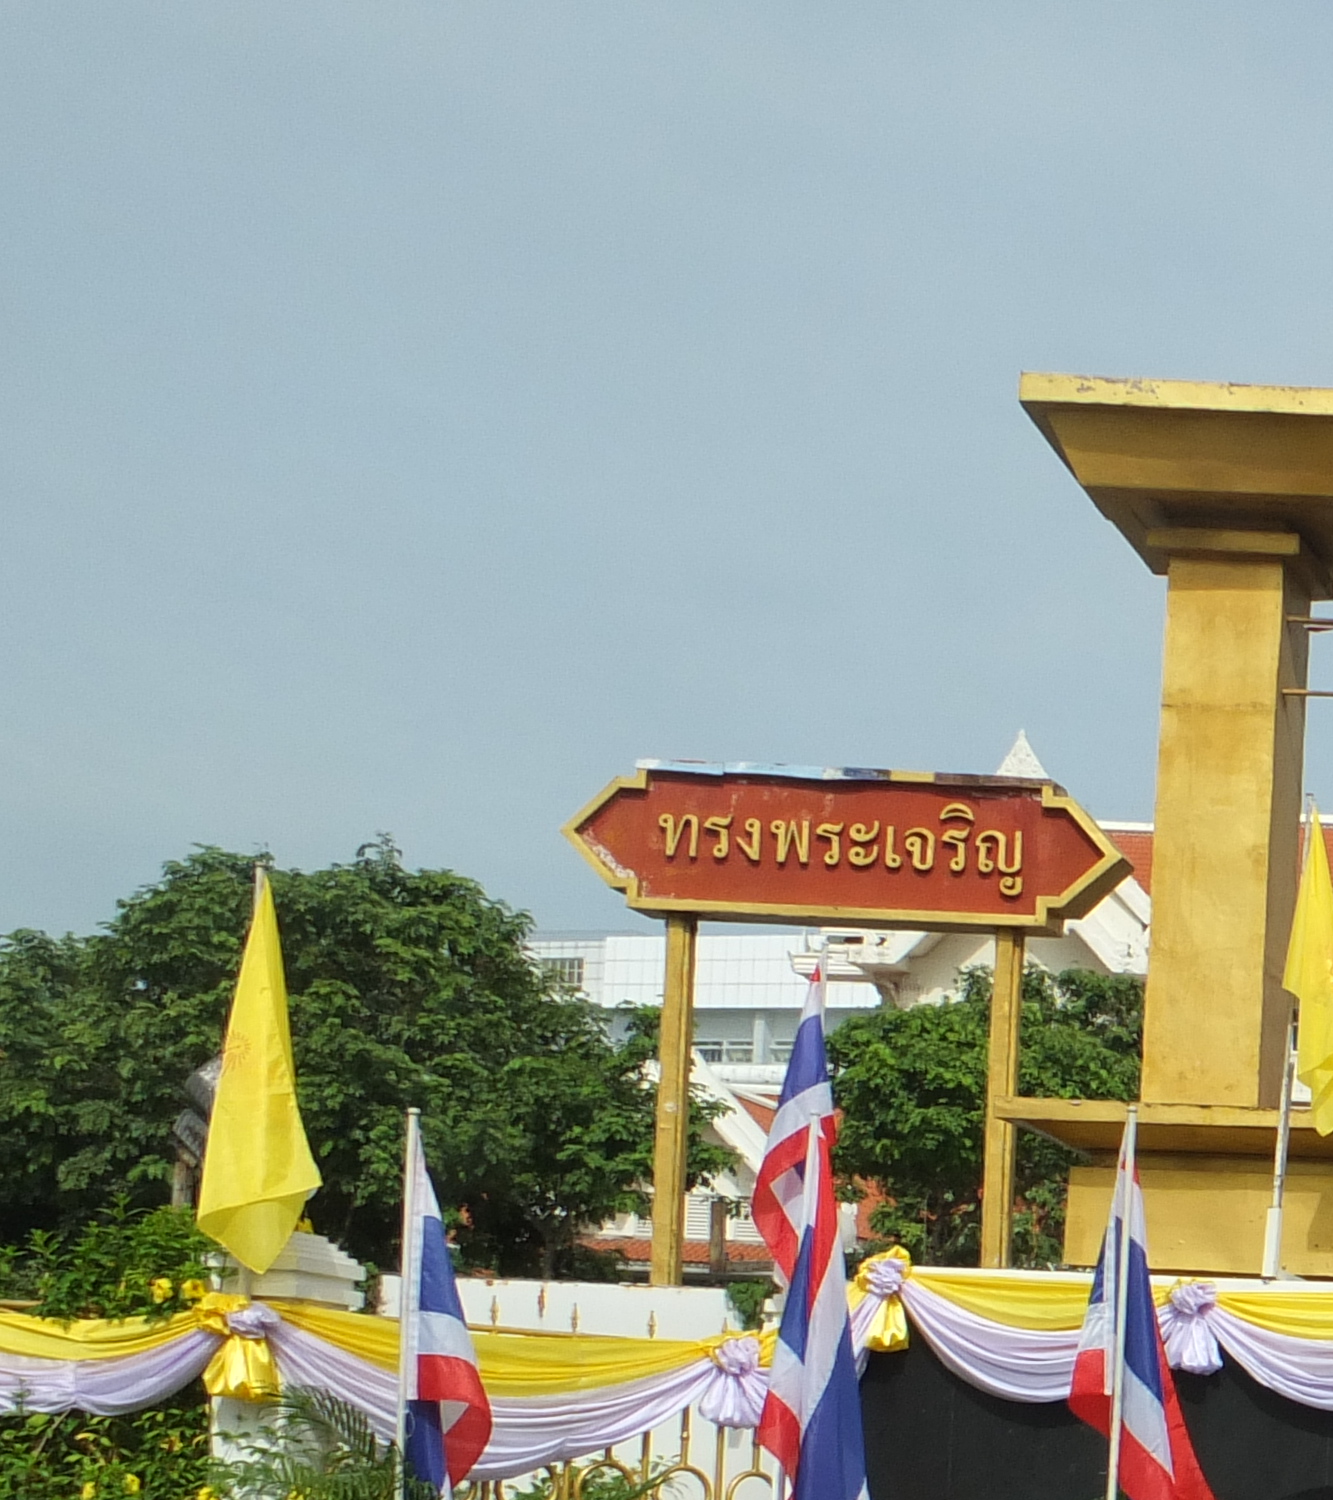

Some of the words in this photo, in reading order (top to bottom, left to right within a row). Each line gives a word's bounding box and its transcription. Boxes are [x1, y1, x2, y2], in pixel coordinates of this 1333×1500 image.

[658, 802, 1023, 896] ทรงพระเจริญ
